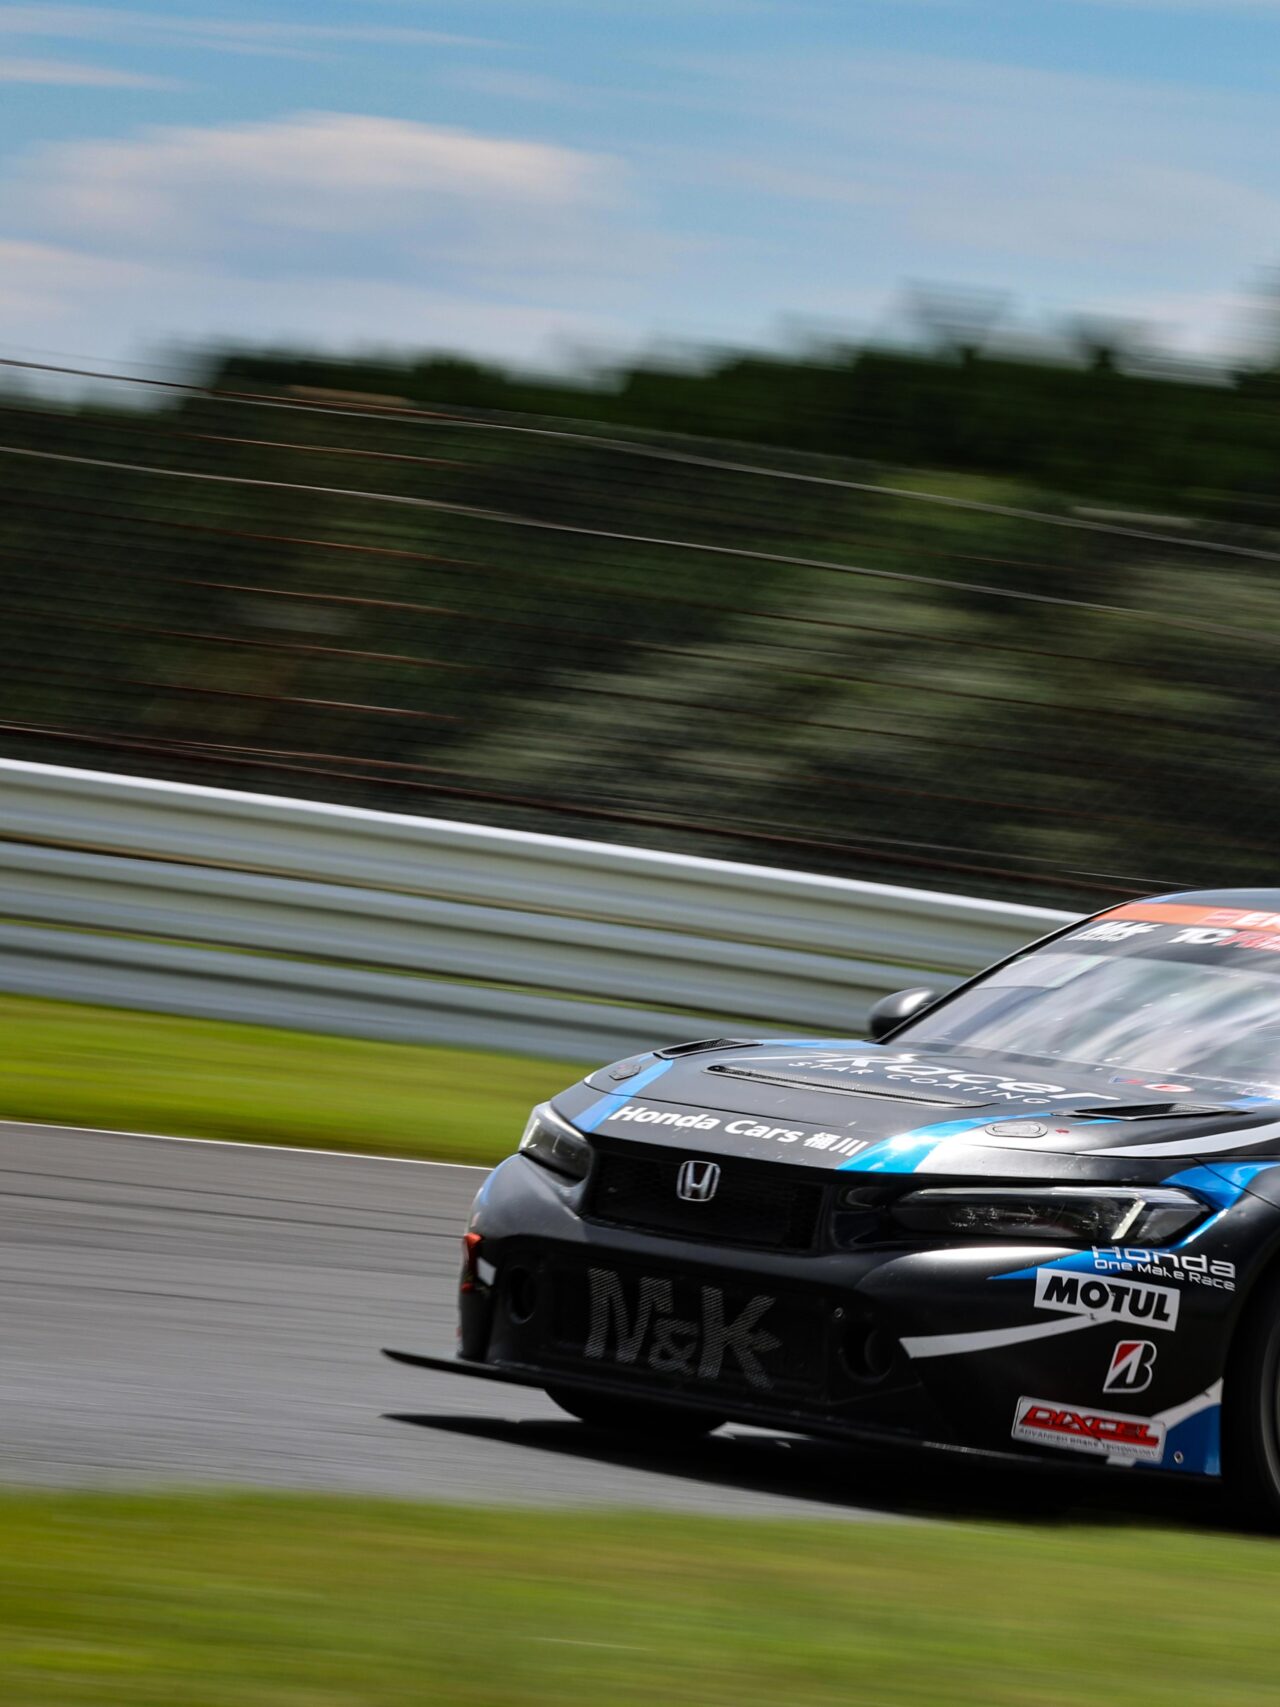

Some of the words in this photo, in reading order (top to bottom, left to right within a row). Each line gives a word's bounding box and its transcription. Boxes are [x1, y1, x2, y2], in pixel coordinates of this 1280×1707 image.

[788, 1061, 875, 1076] STAR
[895, 1073, 1053, 1106] COATING
[608, 1106, 721, 1130] Honda
[724, 1120, 804, 1144] Cars
[1091, 1245, 1236, 1279] Honda
[1094, 1259, 1134, 1272] One
[1137, 1263, 1185, 1280] Make
[1188, 1272, 1236, 1291] Race
[1042, 1275, 1171, 1322] MOTUL
